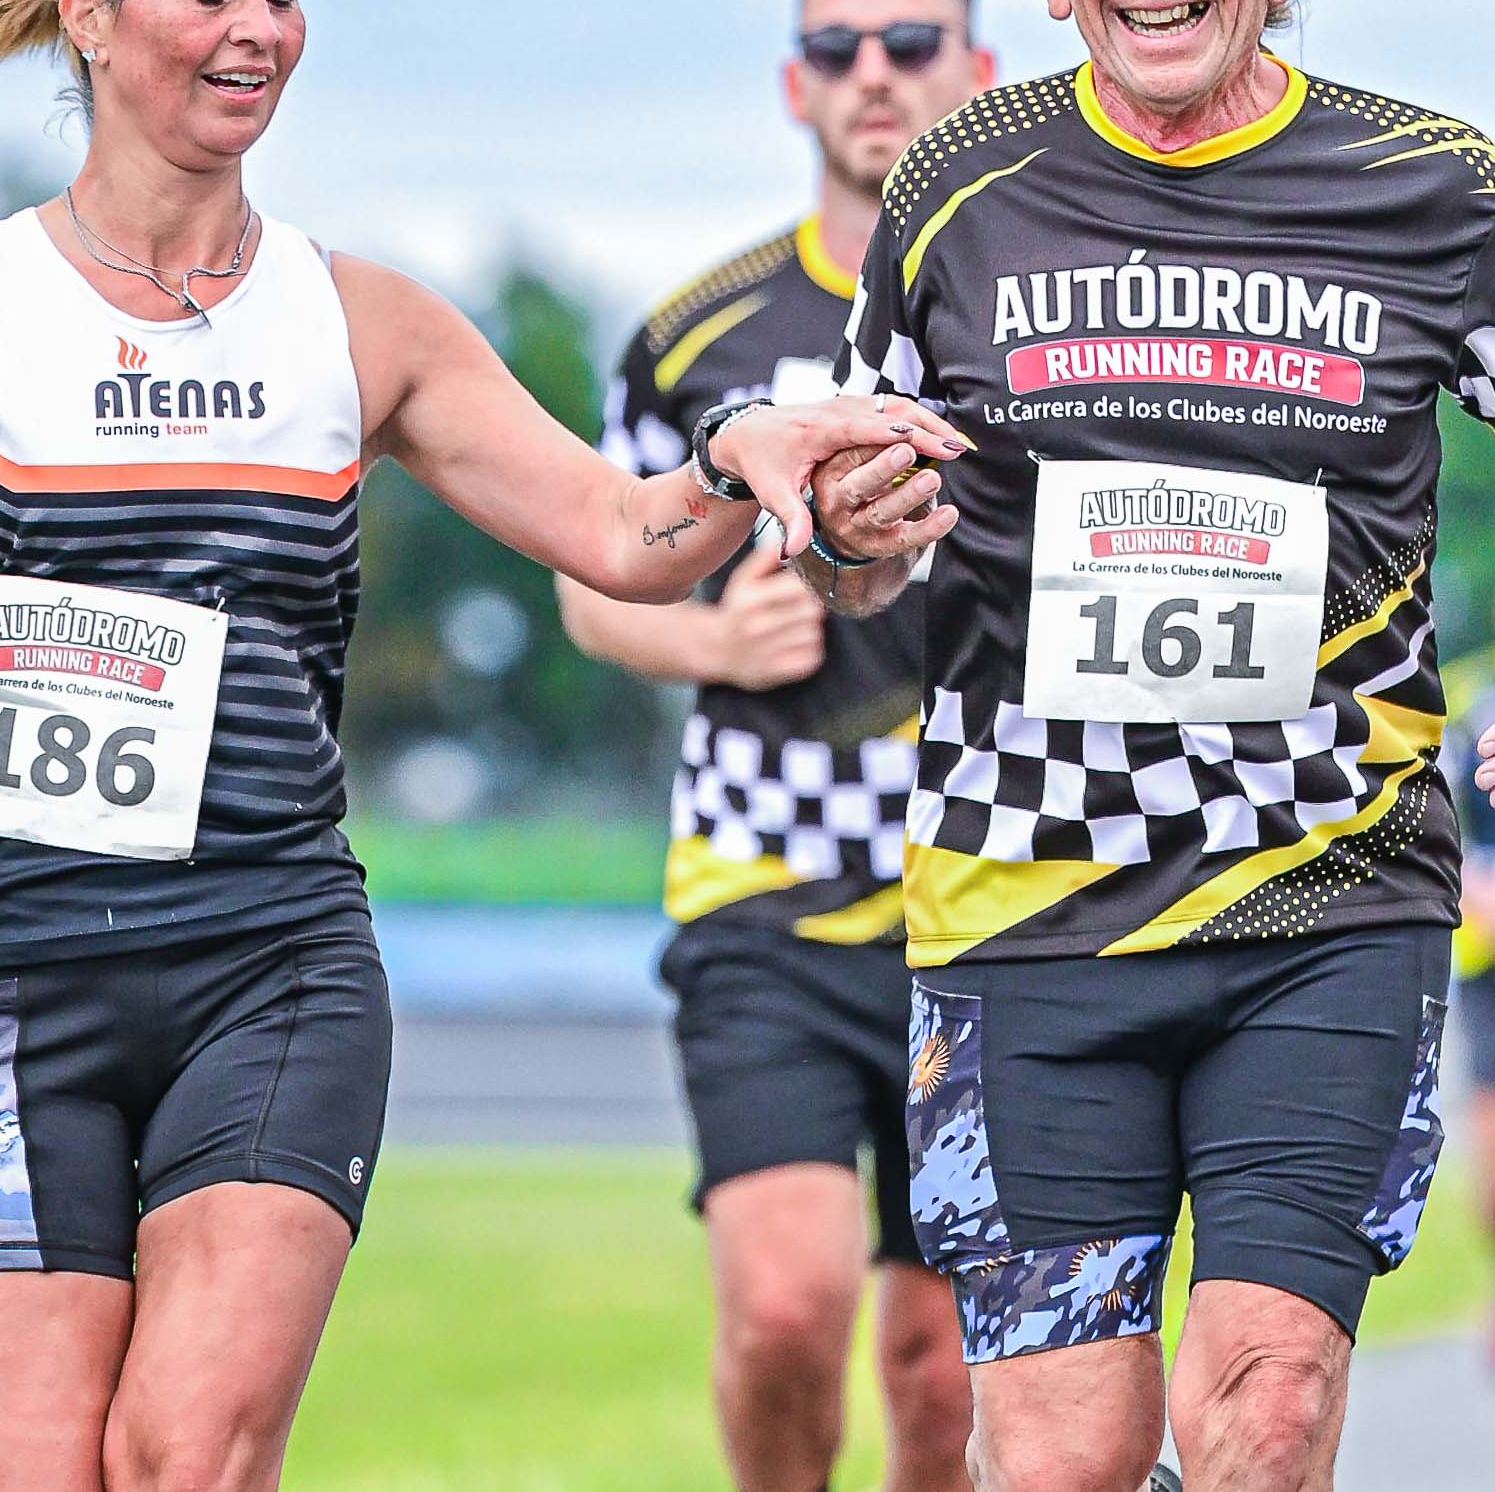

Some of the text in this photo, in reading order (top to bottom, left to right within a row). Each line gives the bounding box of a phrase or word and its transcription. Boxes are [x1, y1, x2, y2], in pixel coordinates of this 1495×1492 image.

[991, 248, 1383, 357] AUTÓDROMO
[1044, 343, 1326, 394] RUNNING RACE
[94, 373, 266, 419] ATENAS
[984, 396, 1387, 435] La Carrera de los Clubes del Noroeste
[96, 423, 208, 438] running team
[1079, 479, 1286, 537] AUTÓDROMO
[1110, 531, 1250, 559] RUNNING RACE
[1072, 561, 1282, 582] La Carrera de los Clubes del Noroeste
[1075, 594, 1265, 680] 161
[13, 648, 147, 685] RUNNING RACE
[31, 678, 44, 690] de
[47, 680, 63, 692] los
[66, 683, 102, 697] Clubes
[105, 689, 123, 701] del
[125, 692, 174, 710] Noroeste
